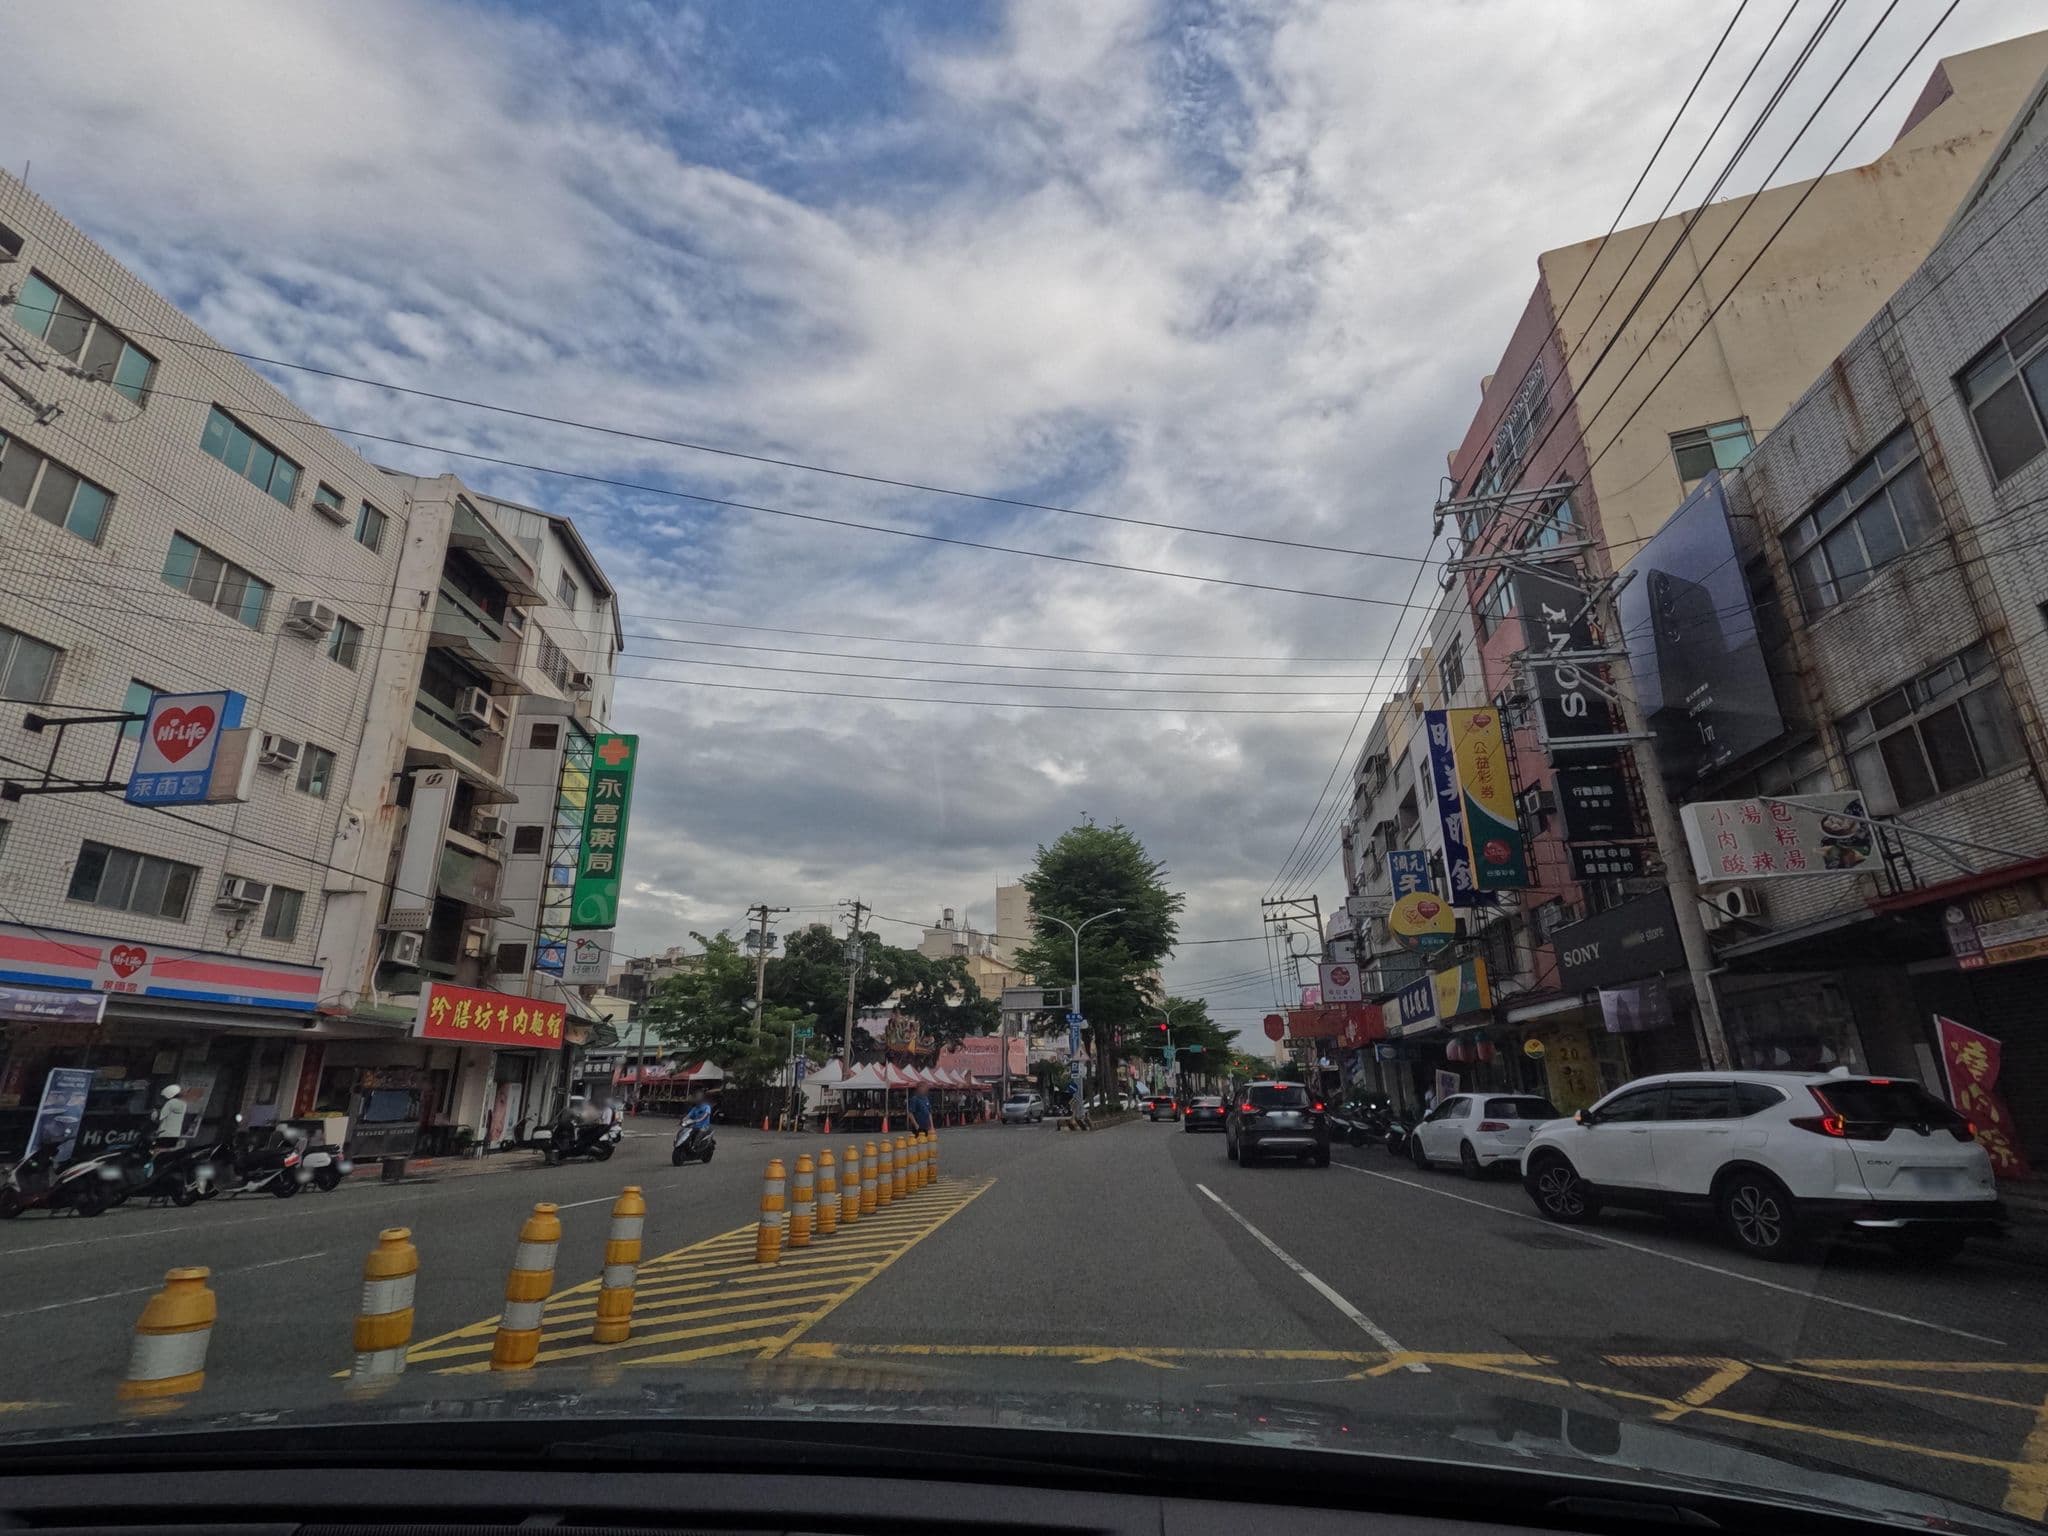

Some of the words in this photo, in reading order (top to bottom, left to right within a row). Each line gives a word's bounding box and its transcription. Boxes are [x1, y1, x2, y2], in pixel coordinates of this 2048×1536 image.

[1542, 602, 1588, 718] SONY
[157, 718, 207, 747] Hi-Life
[586, 778, 623, 873] 永富藥局
[1711, 802, 1793, 826] 小湯包
[1717, 826, 1801, 850] 肉粽
[1721, 849, 1807, 874] 酸辣湯
[1563, 942, 1600, 968] SONY
